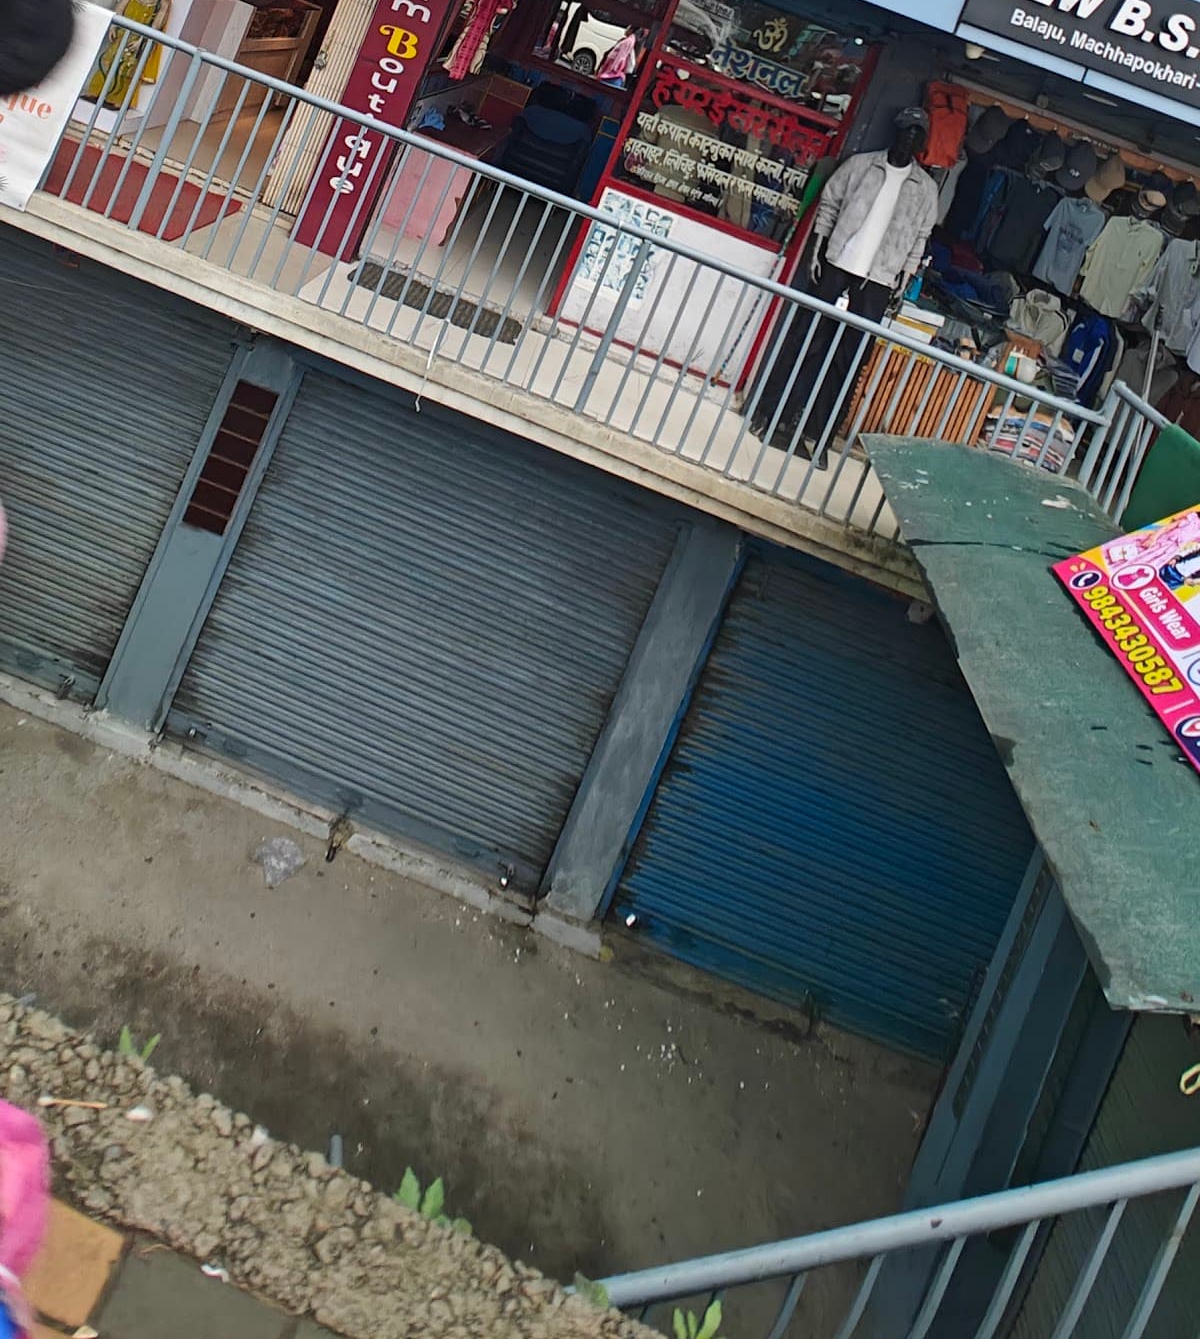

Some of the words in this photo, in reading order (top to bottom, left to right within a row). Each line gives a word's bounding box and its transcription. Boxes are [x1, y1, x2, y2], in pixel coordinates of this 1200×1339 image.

[1011, 8, 1066, 44] Balaju,
[330, 24, 419, 194] Boutque
[1083, 585, 1184, 694] 9843430587
[1138, 587, 1169, 613] Girls
[1158, 608, 1190, 641] Wear
